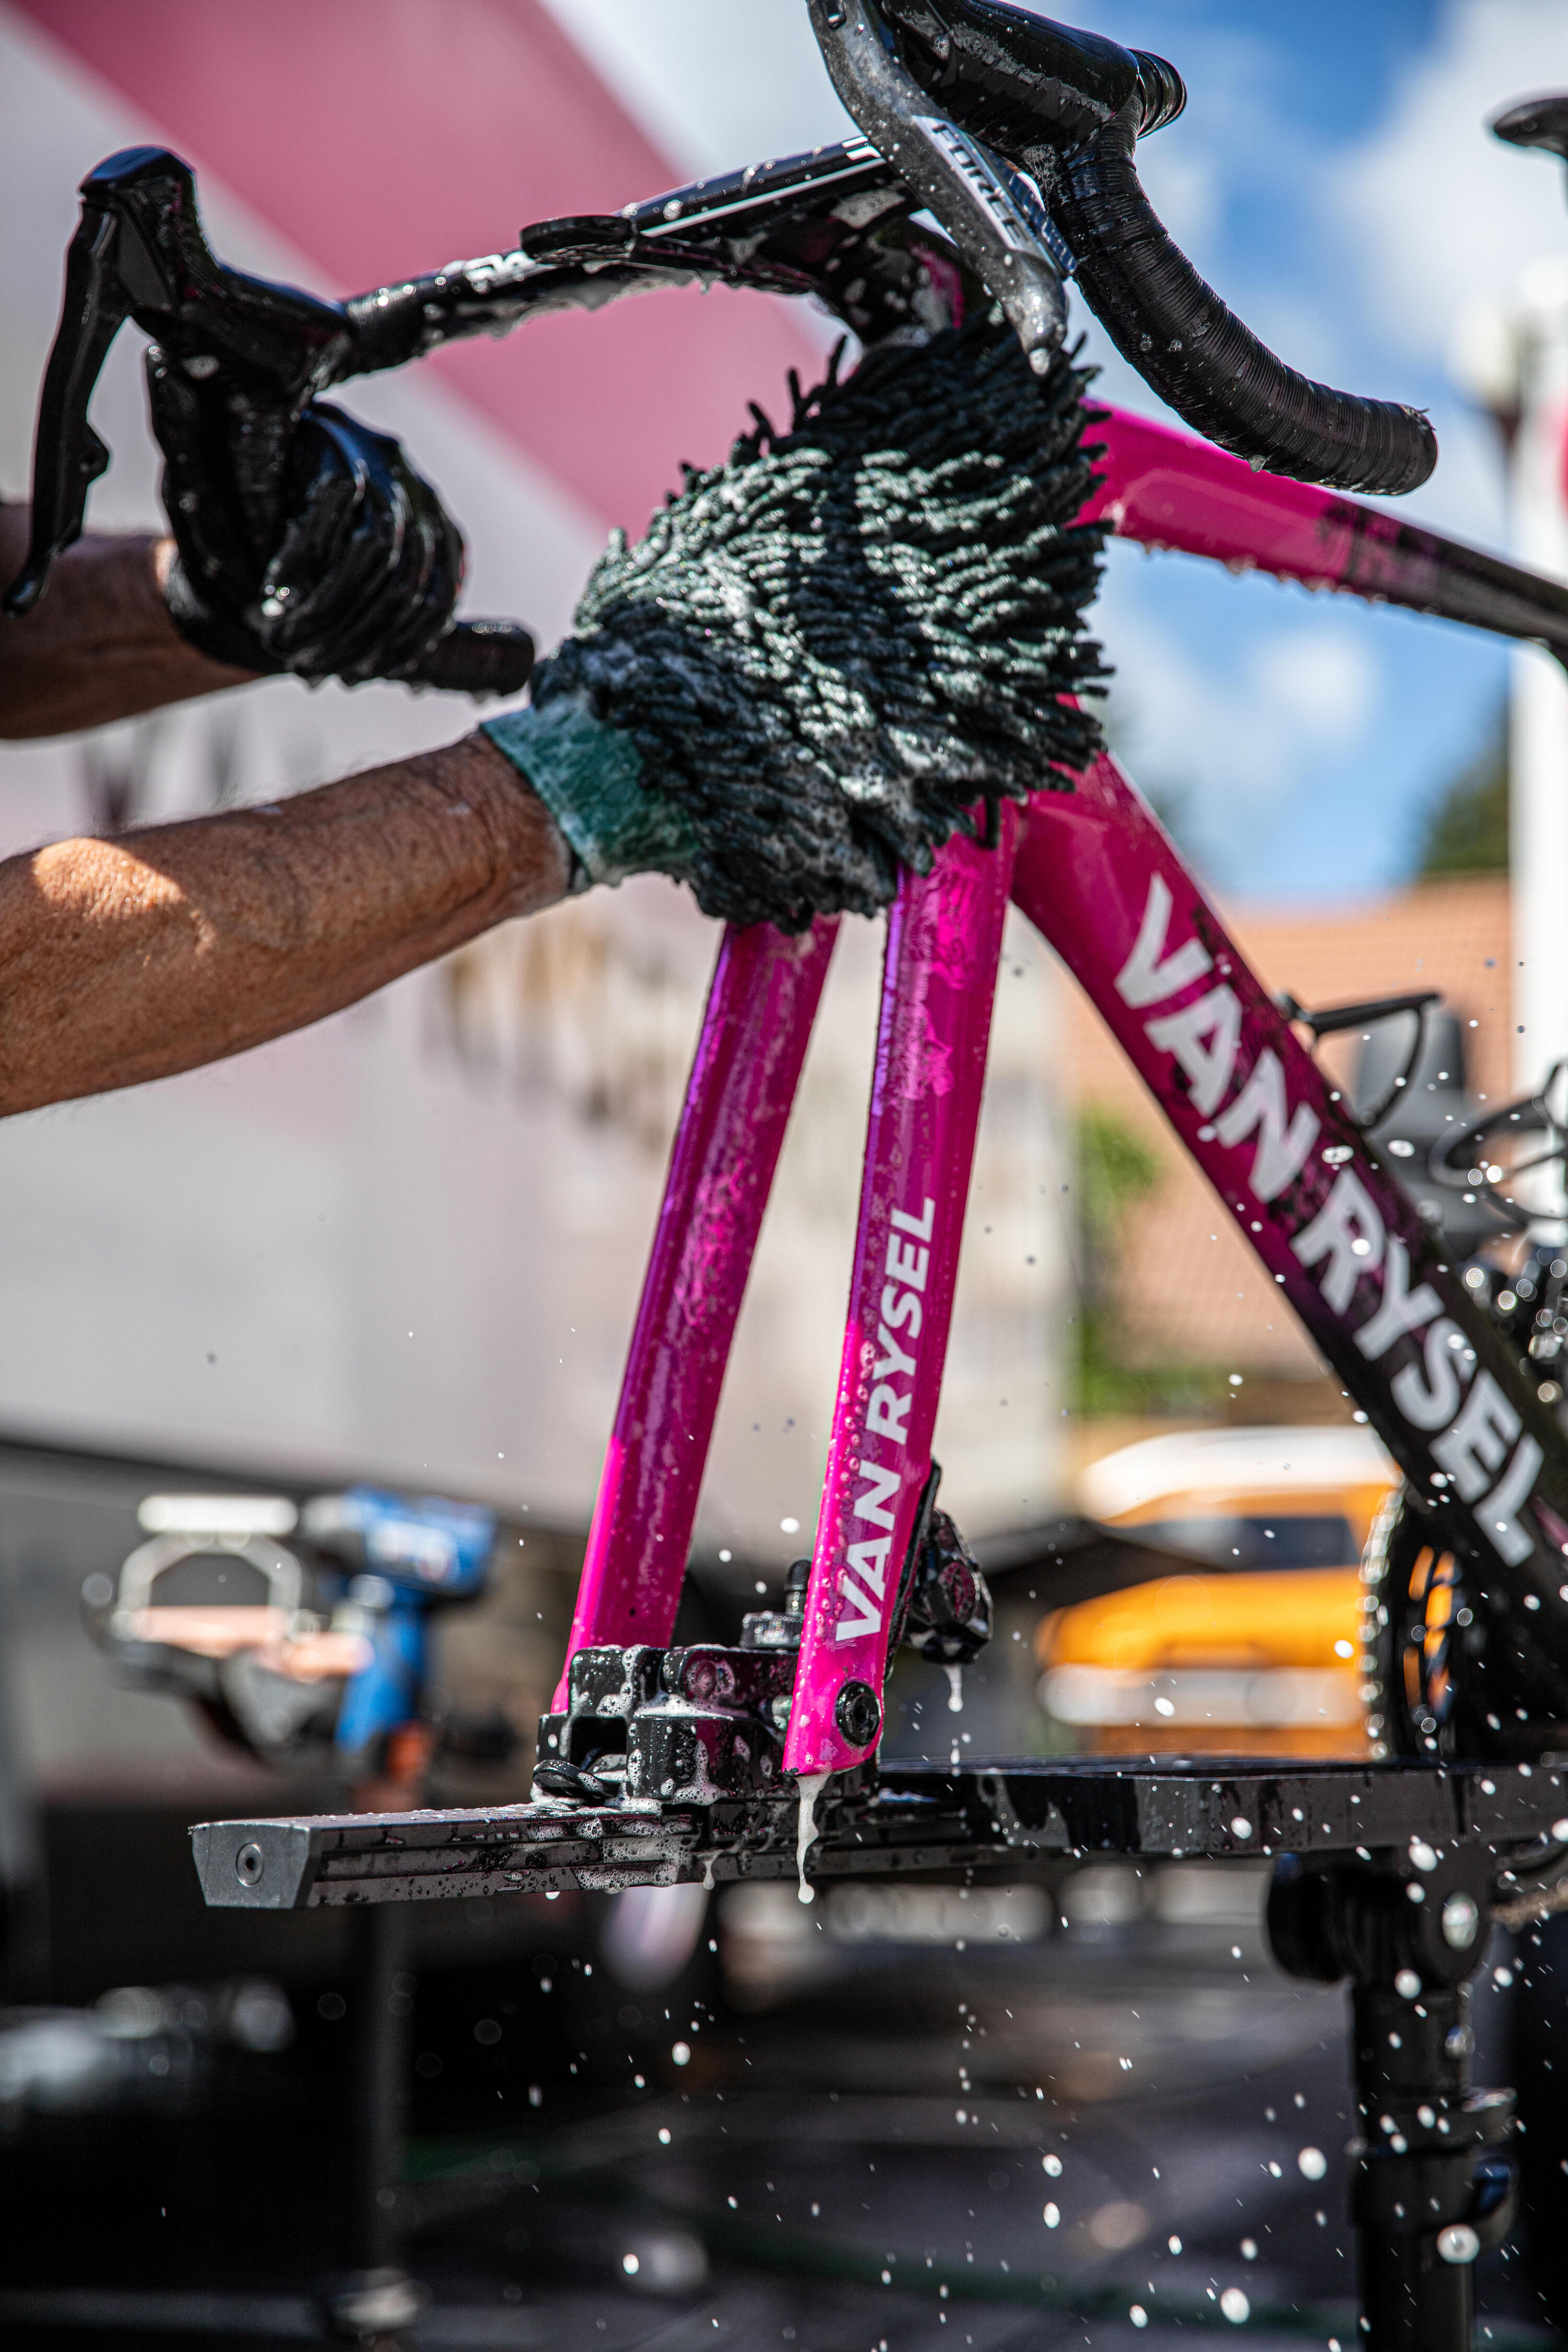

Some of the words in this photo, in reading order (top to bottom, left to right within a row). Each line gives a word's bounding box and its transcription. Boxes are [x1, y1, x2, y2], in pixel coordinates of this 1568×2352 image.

[931, 122, 1031, 244] FORCE
[866, 1197, 936, 1446] RYSEL
[1114, 872, 1320, 1203] VAN
[1290, 1168, 1544, 1566] RYSEL
[835, 1459, 901, 1642] VAN
